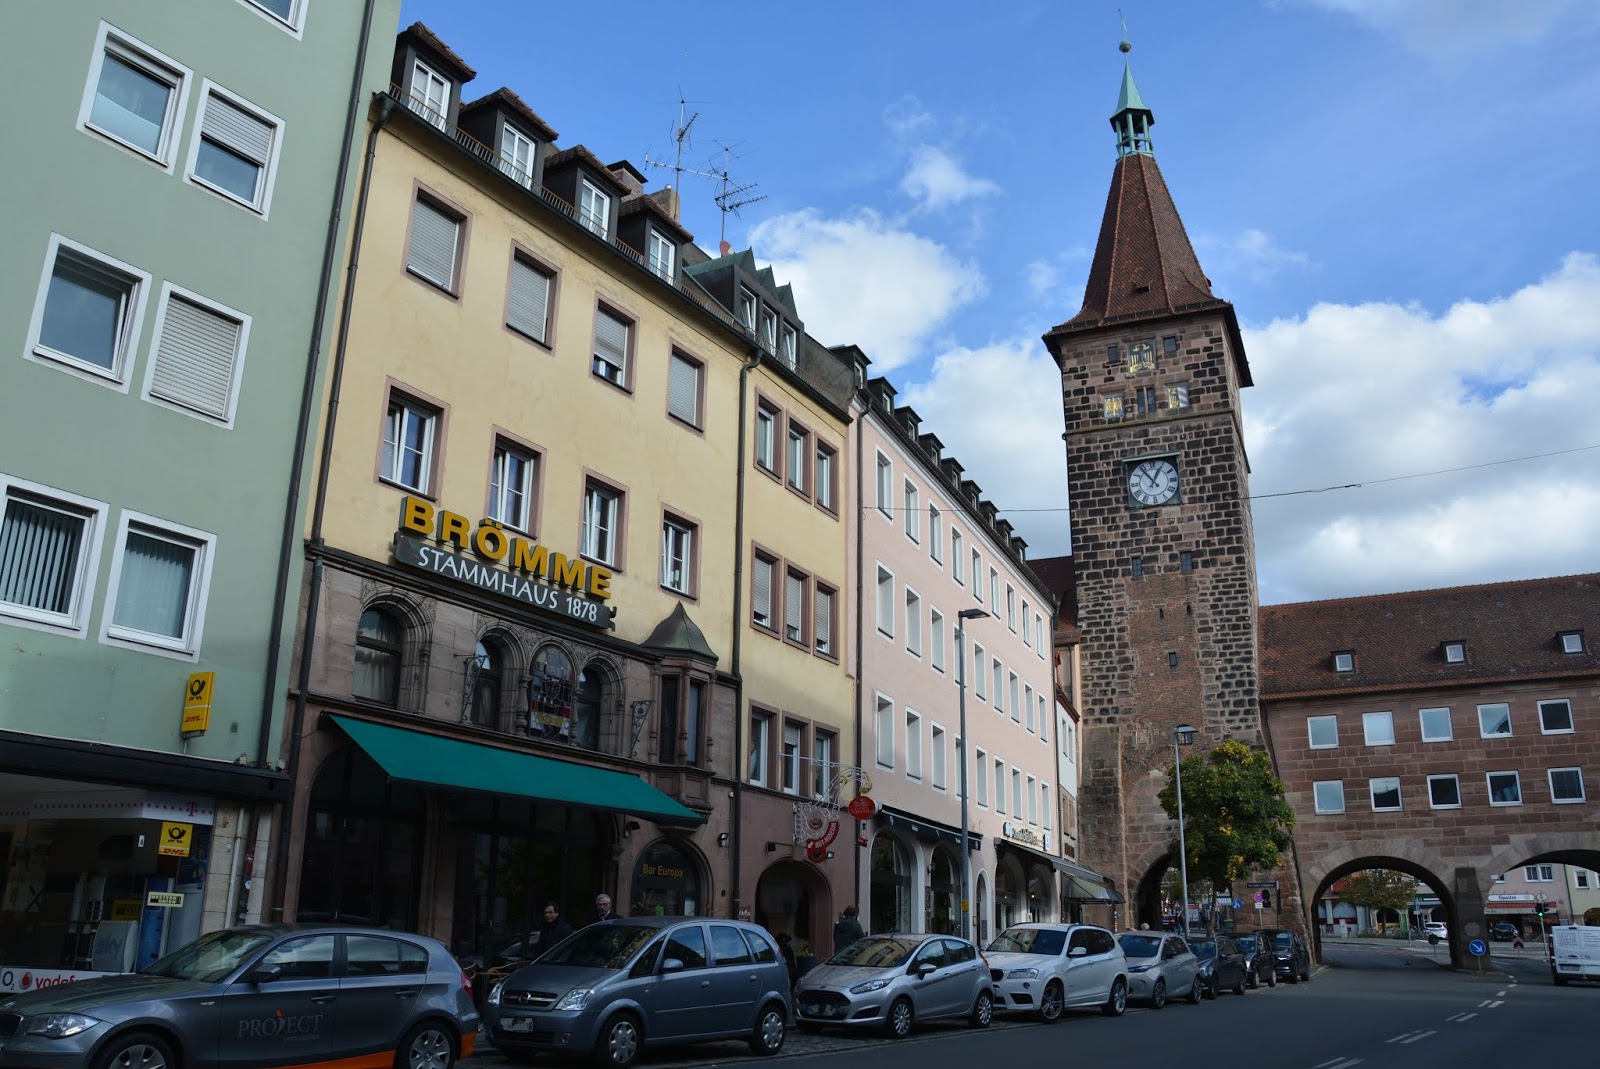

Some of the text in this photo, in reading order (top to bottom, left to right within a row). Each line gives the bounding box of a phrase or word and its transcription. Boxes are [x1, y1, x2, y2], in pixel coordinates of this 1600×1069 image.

[400, 495, 612, 600] BRÖMME
[418, 546, 598, 622] STAMMHAUS 1878
[163, 848, 185, 856] DHL
[642, 864, 684, 878] Bar Europa
[96, 933, 123, 960] sky
